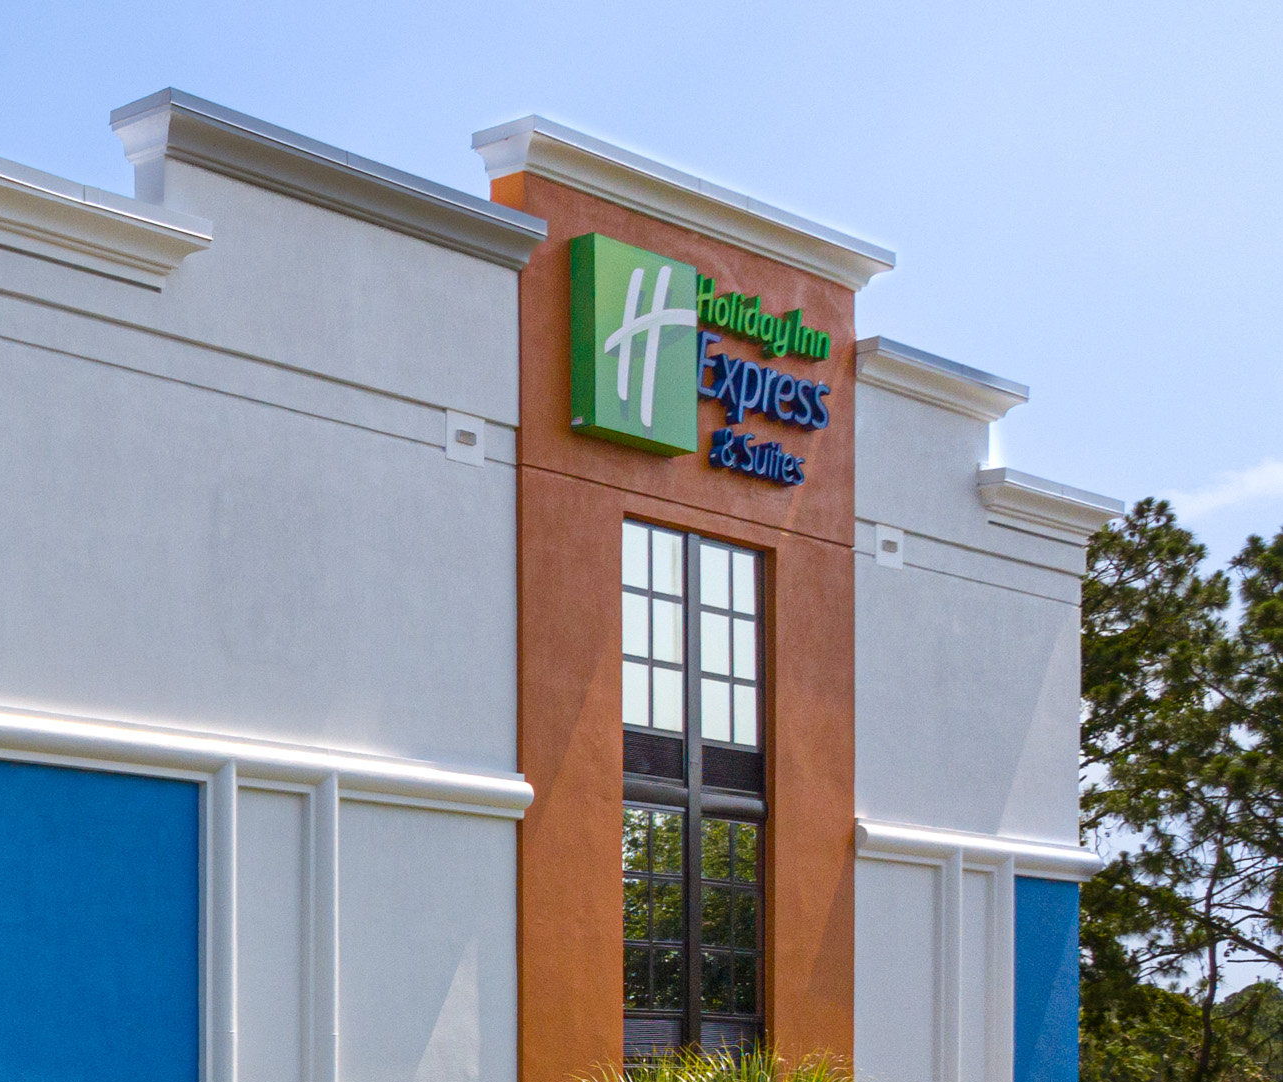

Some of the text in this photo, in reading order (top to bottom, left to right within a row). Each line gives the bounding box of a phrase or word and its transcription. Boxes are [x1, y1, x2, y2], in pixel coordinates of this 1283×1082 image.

[697, 273, 830, 360] Holiday Inn
[697, 331, 830, 430] Express
[711, 428, 805, 485] & Suites
